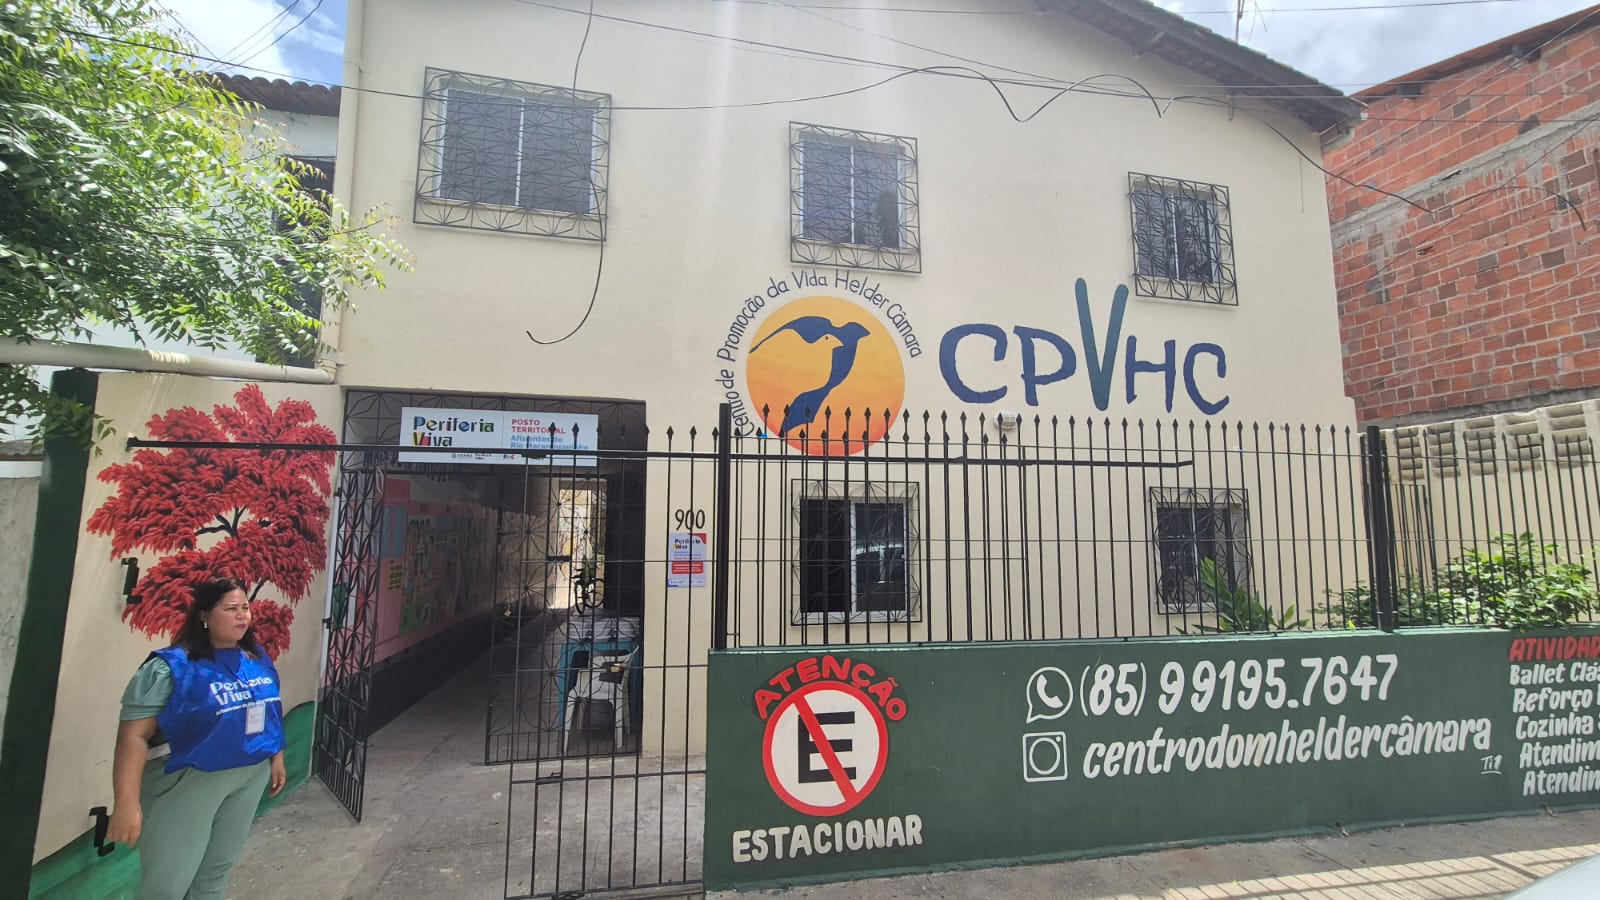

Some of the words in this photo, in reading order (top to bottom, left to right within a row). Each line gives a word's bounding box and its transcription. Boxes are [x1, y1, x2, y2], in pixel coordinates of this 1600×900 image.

[766, 277, 790, 299] da
[791, 269, 829, 289] Vida
[835, 269, 890, 309] Helder
[716, 293, 766, 362] Promoção
[886, 303, 922, 359] Câmara
[938, 277, 1230, 415] CPVHC
[715, 369, 735, 389] de
[413, 416, 494, 432] Periferia
[511, 418, 541, 426] POSTO
[511, 426, 566, 434] TERRITOAL
[412, 431, 453, 447] Viva
[675, 509, 705, 531] 900
[1509, 663, 1566, 686] Ballet
[215, 690, 252, 706] Viva
[754, 655, 907, 721] ATENÇÃO
[1080, 661, 1147, 717] (85)
[1512, 686, 1593, 714] Reforço
[1515, 711, 1593, 740] Cozinha
[1083, 714, 1492, 779] centrodomheldercâmara
[732, 814, 924, 863] ESTACIONAR
